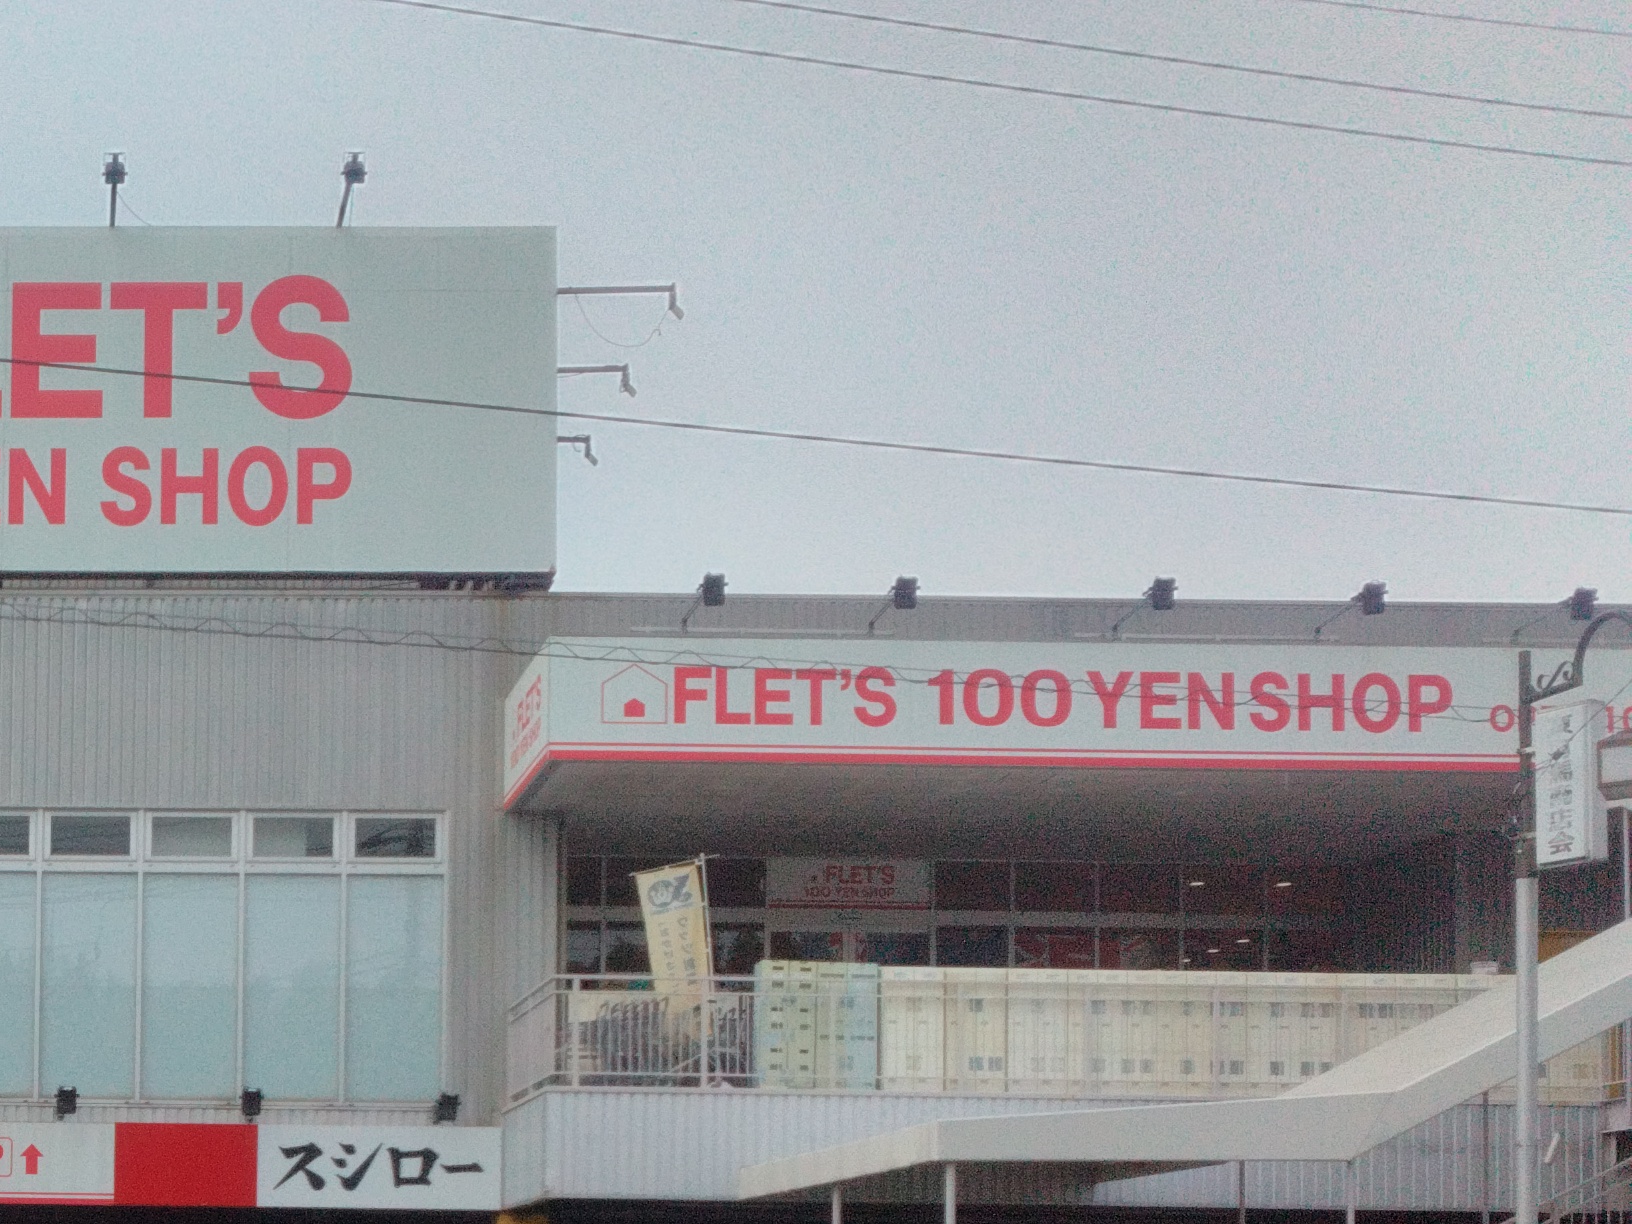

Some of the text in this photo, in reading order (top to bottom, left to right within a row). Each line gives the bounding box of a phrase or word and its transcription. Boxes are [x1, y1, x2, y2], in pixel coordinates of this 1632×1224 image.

[100, 446, 353, 528] SHOP
[672, 664, 897, 729] FLET'S
[928, 669, 1073, 728] 100
[1088, 670, 1235, 731] YEN
[1249, 671, 1453, 734] SHOP
[824, 864, 896, 885] FLET'S
[273, 1141, 485, 1192] スシロー
